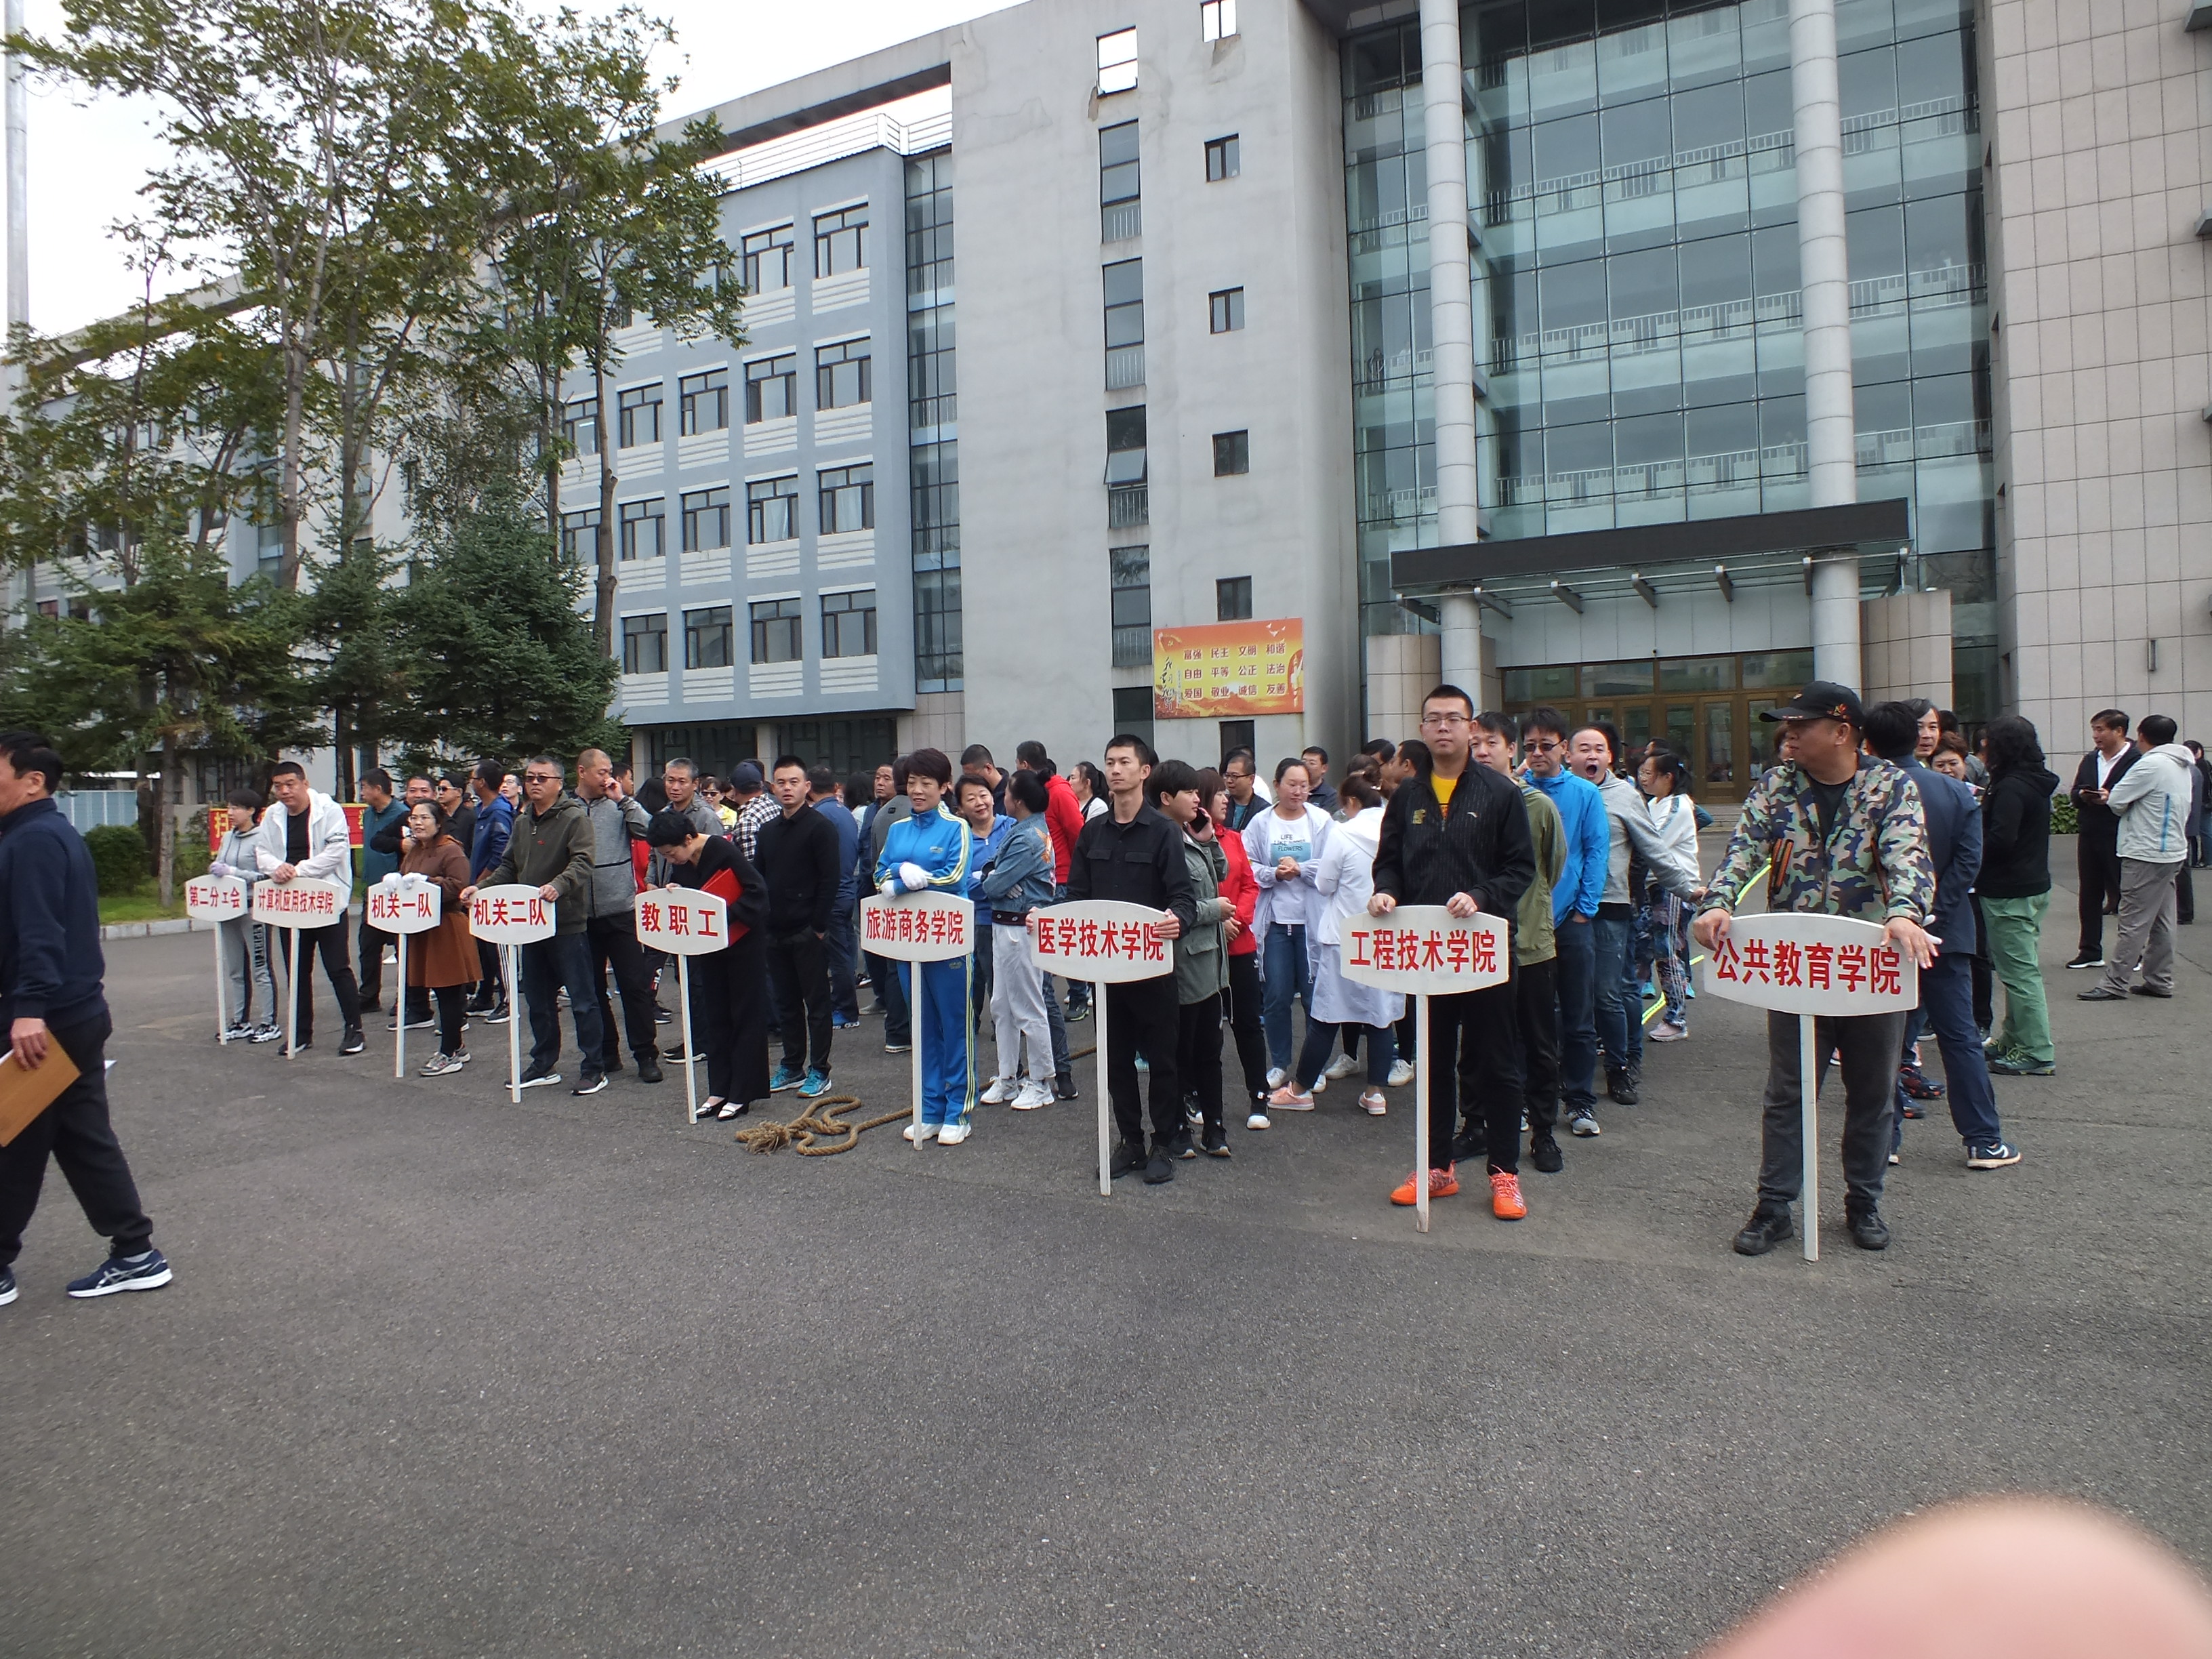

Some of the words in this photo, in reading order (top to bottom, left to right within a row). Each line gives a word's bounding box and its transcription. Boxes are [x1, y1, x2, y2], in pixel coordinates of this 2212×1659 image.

[1184, 649, 1202, 660] 富强
[1211, 648, 1229, 659] 民主
[1238, 646, 1257, 657] 文明
[1266, 643, 1285, 654] 和谐
[1185, 669, 1202, 679] 自由
[1211, 668, 1229, 678] 平等
[1238, 665, 1257, 676] 公正
[1267, 664, 1285, 674] 法治
[1184, 689, 1202, 699] 爱国
[1211, 687, 1229, 697] 敬业
[1239, 685, 1257, 696] 诚信
[1267, 684, 1286, 695] 友善
[190, 886, 240, 908] 第二分工会
[259, 888, 333, 914] 计算机应用技术学院
[372, 893, 432, 918] 机关一队
[474, 898, 547, 926] 机关二队
[641, 902, 718, 937] 教职工
[866, 907, 964, 945] 旅游商务学院
[1038, 918, 1164, 961] 医学技术学院
[1350, 928, 1496, 973] 工程技术学院
[1712, 938, 1901, 995] 公共教育学院
